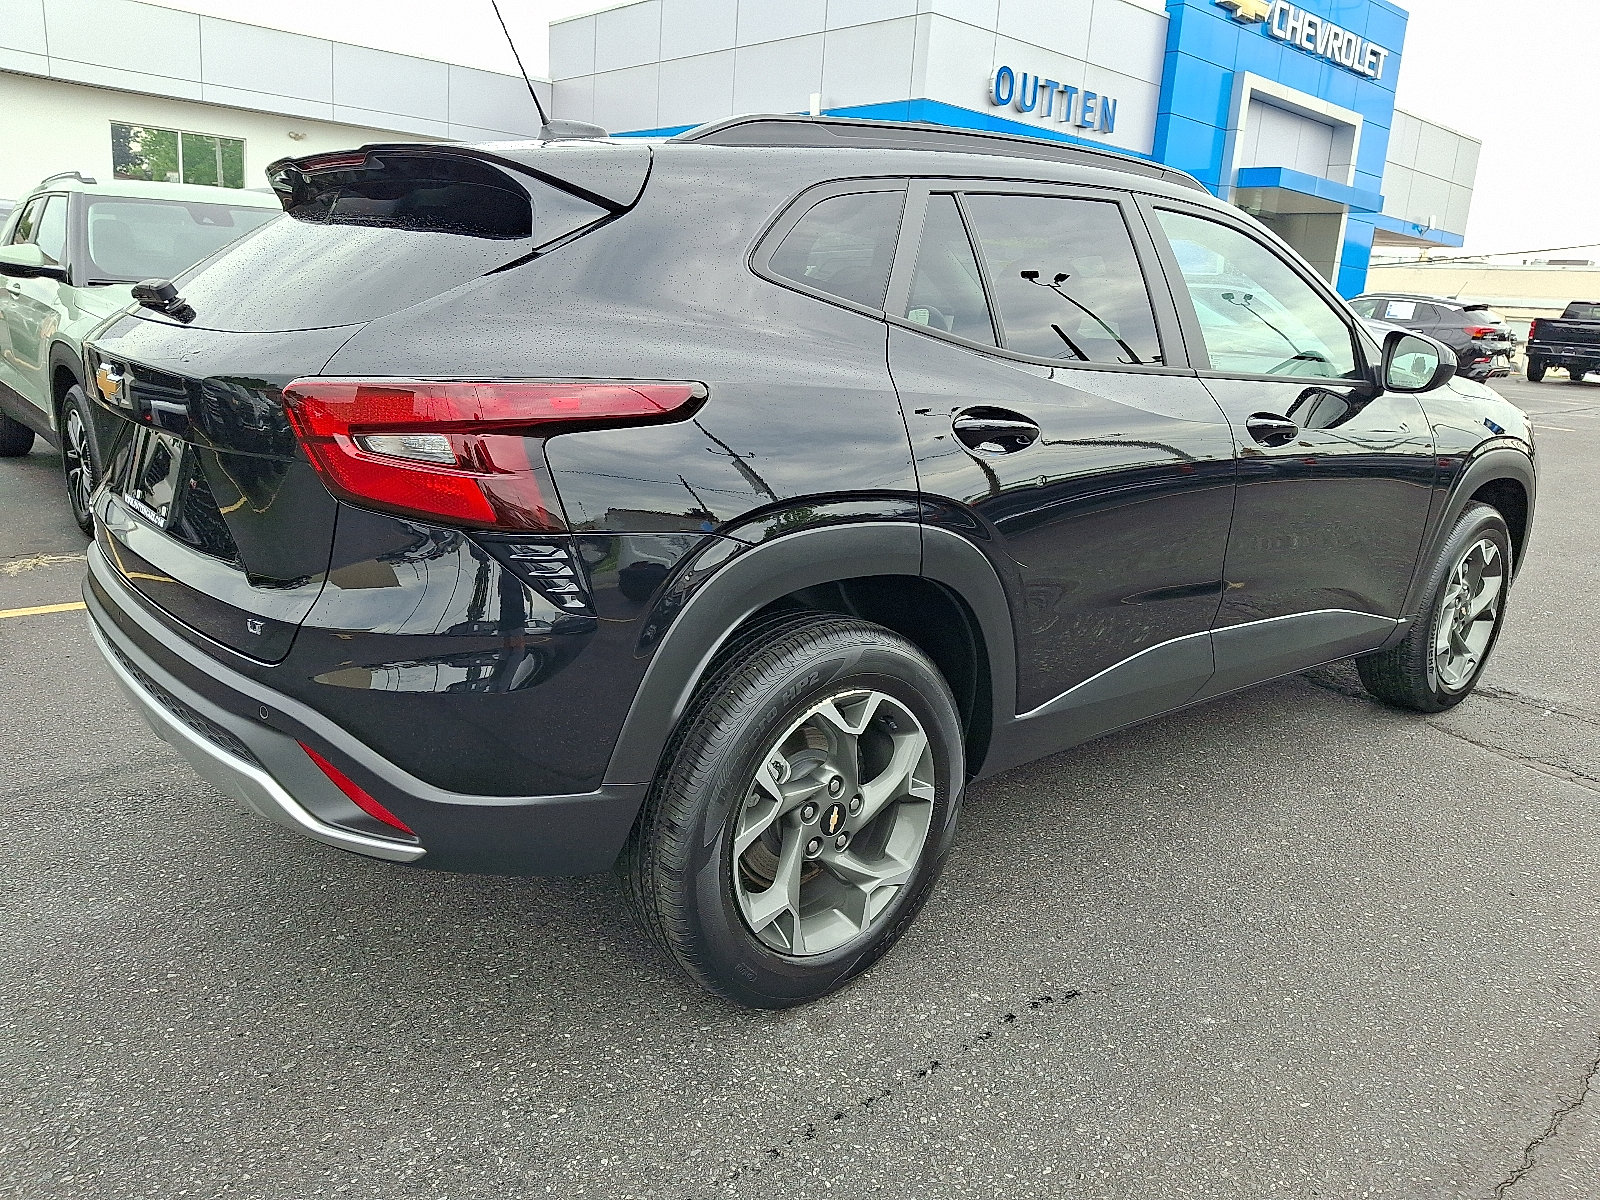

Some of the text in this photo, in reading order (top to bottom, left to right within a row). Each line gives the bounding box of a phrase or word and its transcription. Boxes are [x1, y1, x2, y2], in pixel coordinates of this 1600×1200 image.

[1271, 0, 1389, 80] CHEVROLET
[989, 65, 1118, 134] OUTTEN
[246, 617, 265, 636] LT
[781, 671, 820, 706] HP2
